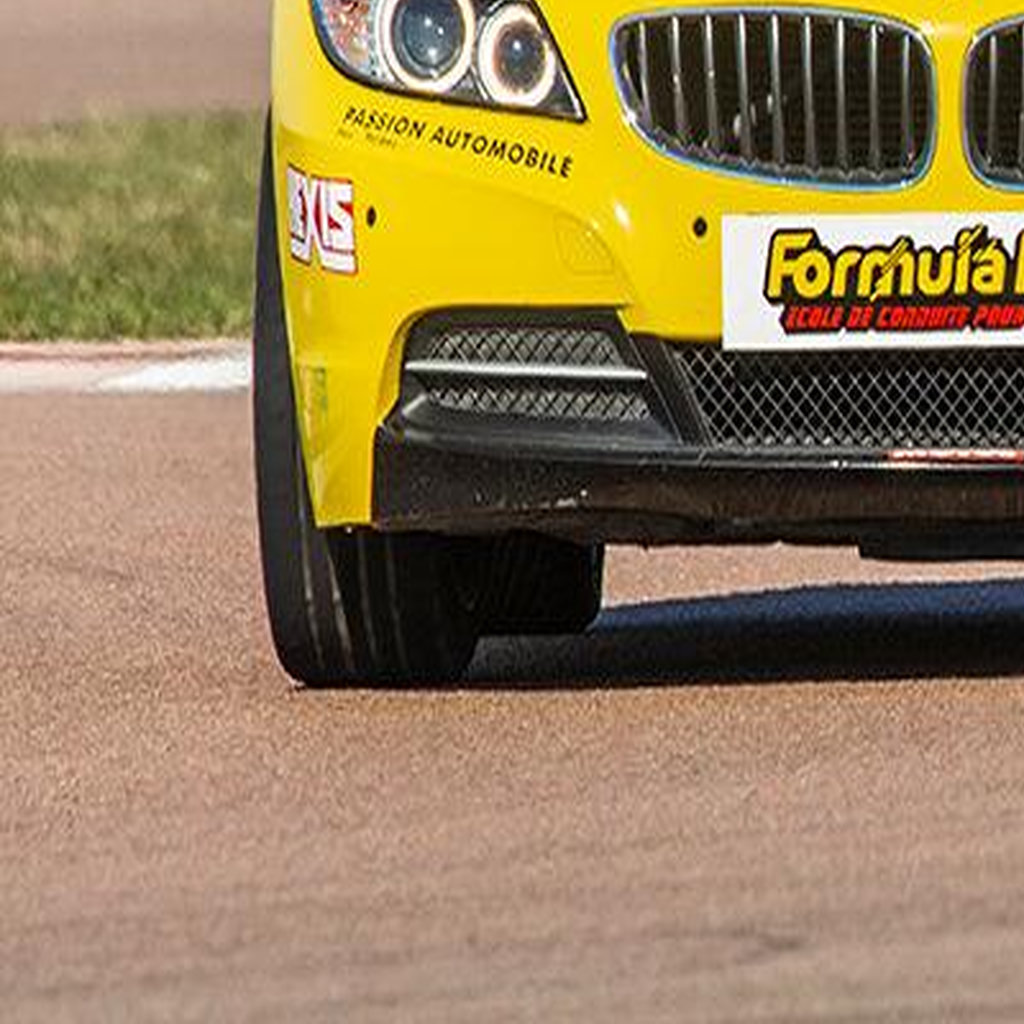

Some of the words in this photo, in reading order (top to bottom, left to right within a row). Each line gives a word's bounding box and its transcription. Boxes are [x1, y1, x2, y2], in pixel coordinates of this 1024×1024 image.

[342, 106, 427, 139] PASSION
[430, 124, 574, 179] AUTOMOBILE
[763, 223, 1008, 303] Formula
